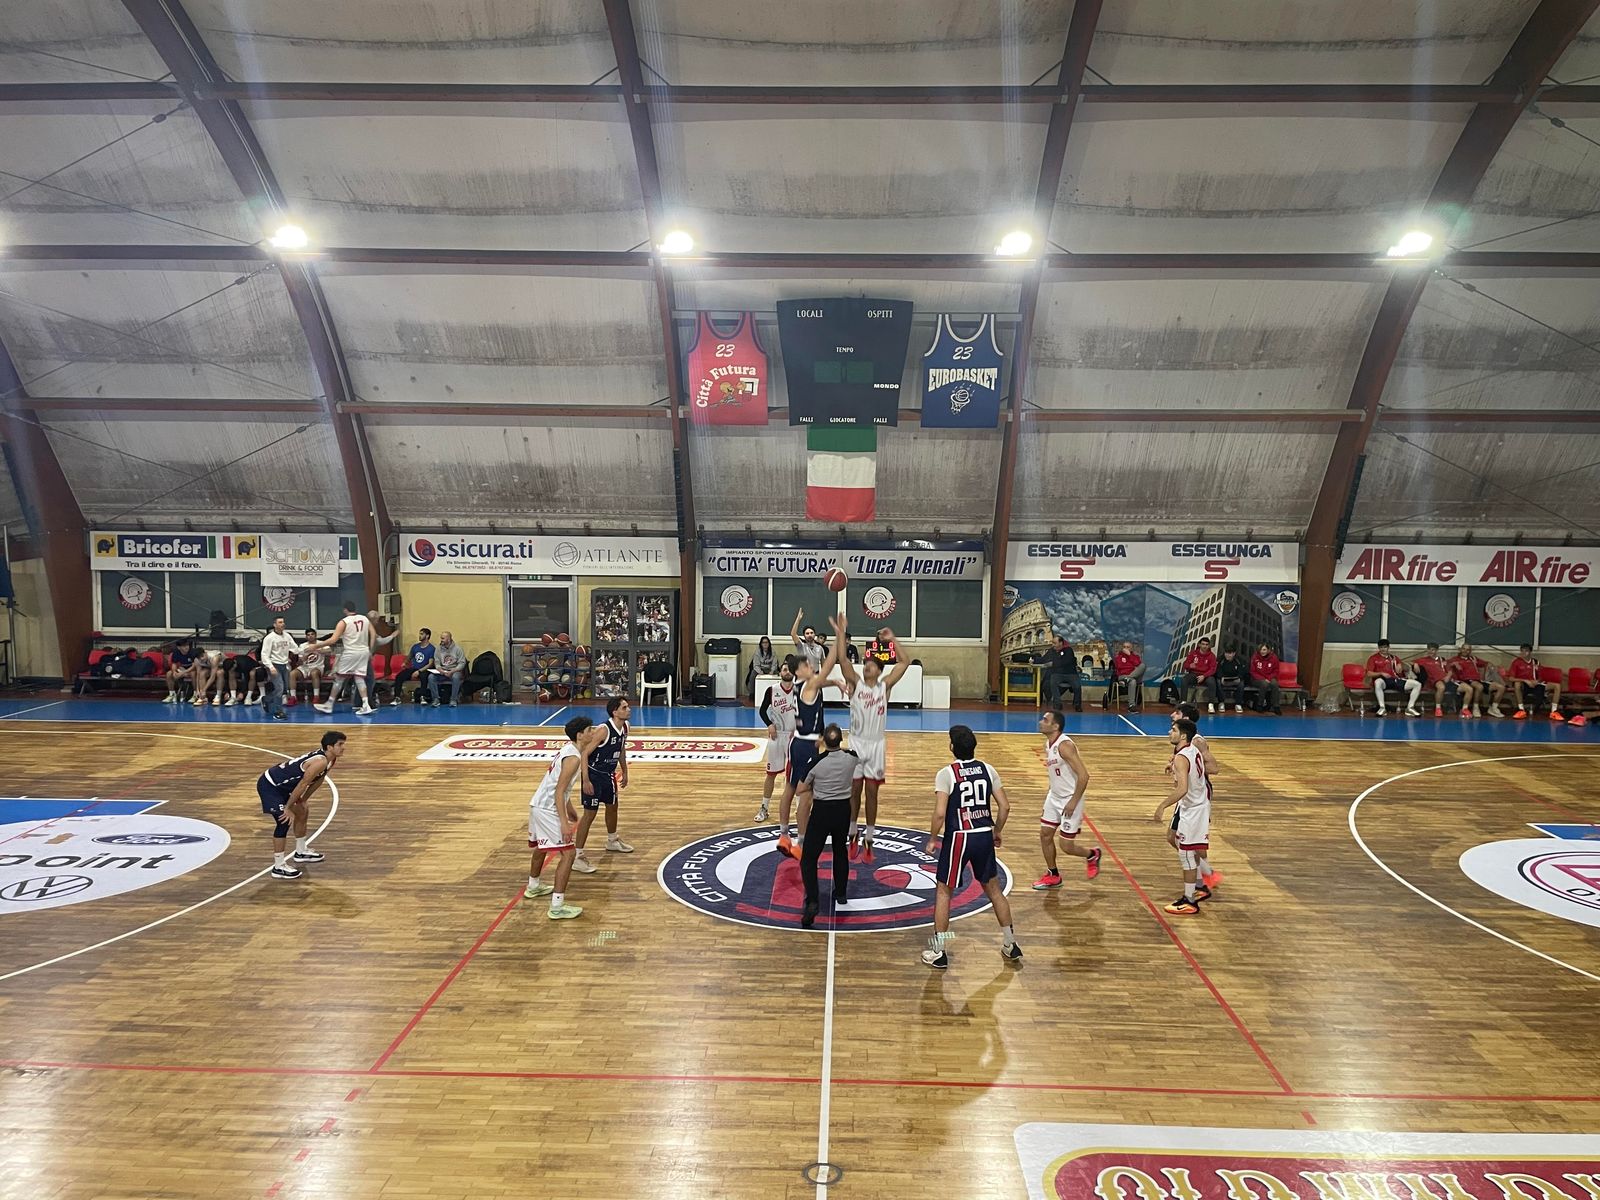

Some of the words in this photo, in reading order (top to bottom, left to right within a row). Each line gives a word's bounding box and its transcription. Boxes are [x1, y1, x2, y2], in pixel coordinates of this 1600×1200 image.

[796, 309, 823, 318] LOCALI
[867, 309, 893, 318] OSPITI
[715, 344, 736, 358] 23
[952, 346, 973, 360] 23
[696, 378, 714, 408] Città
[709, 364, 757, 379] Futura
[928, 367, 997, 392] EUROBASKET
[123, 538, 201, 554] Bricofer
[1027, 544, 1127, 558] ESSELUNGA
[1171, 544, 1272, 558] ESSELUNGA
[584, 549, 662, 563] ATLANTE
[175, 561, 179, 569] il
[181, 561, 202, 569] fare.
[354, 620, 364, 632] 17
[872, 641, 878, 649] 0
[889, 641, 894, 649] 0
[463, 740, 537, 749] OLD
[642, 741, 744, 750] WEST
[610, 736, 617, 744] 15
[959, 779, 988, 808] 20
[591, 798, 599, 806] 15
[682, 836, 752, 870] FUTURA
[676, 871, 728, 902] CITTÀ
